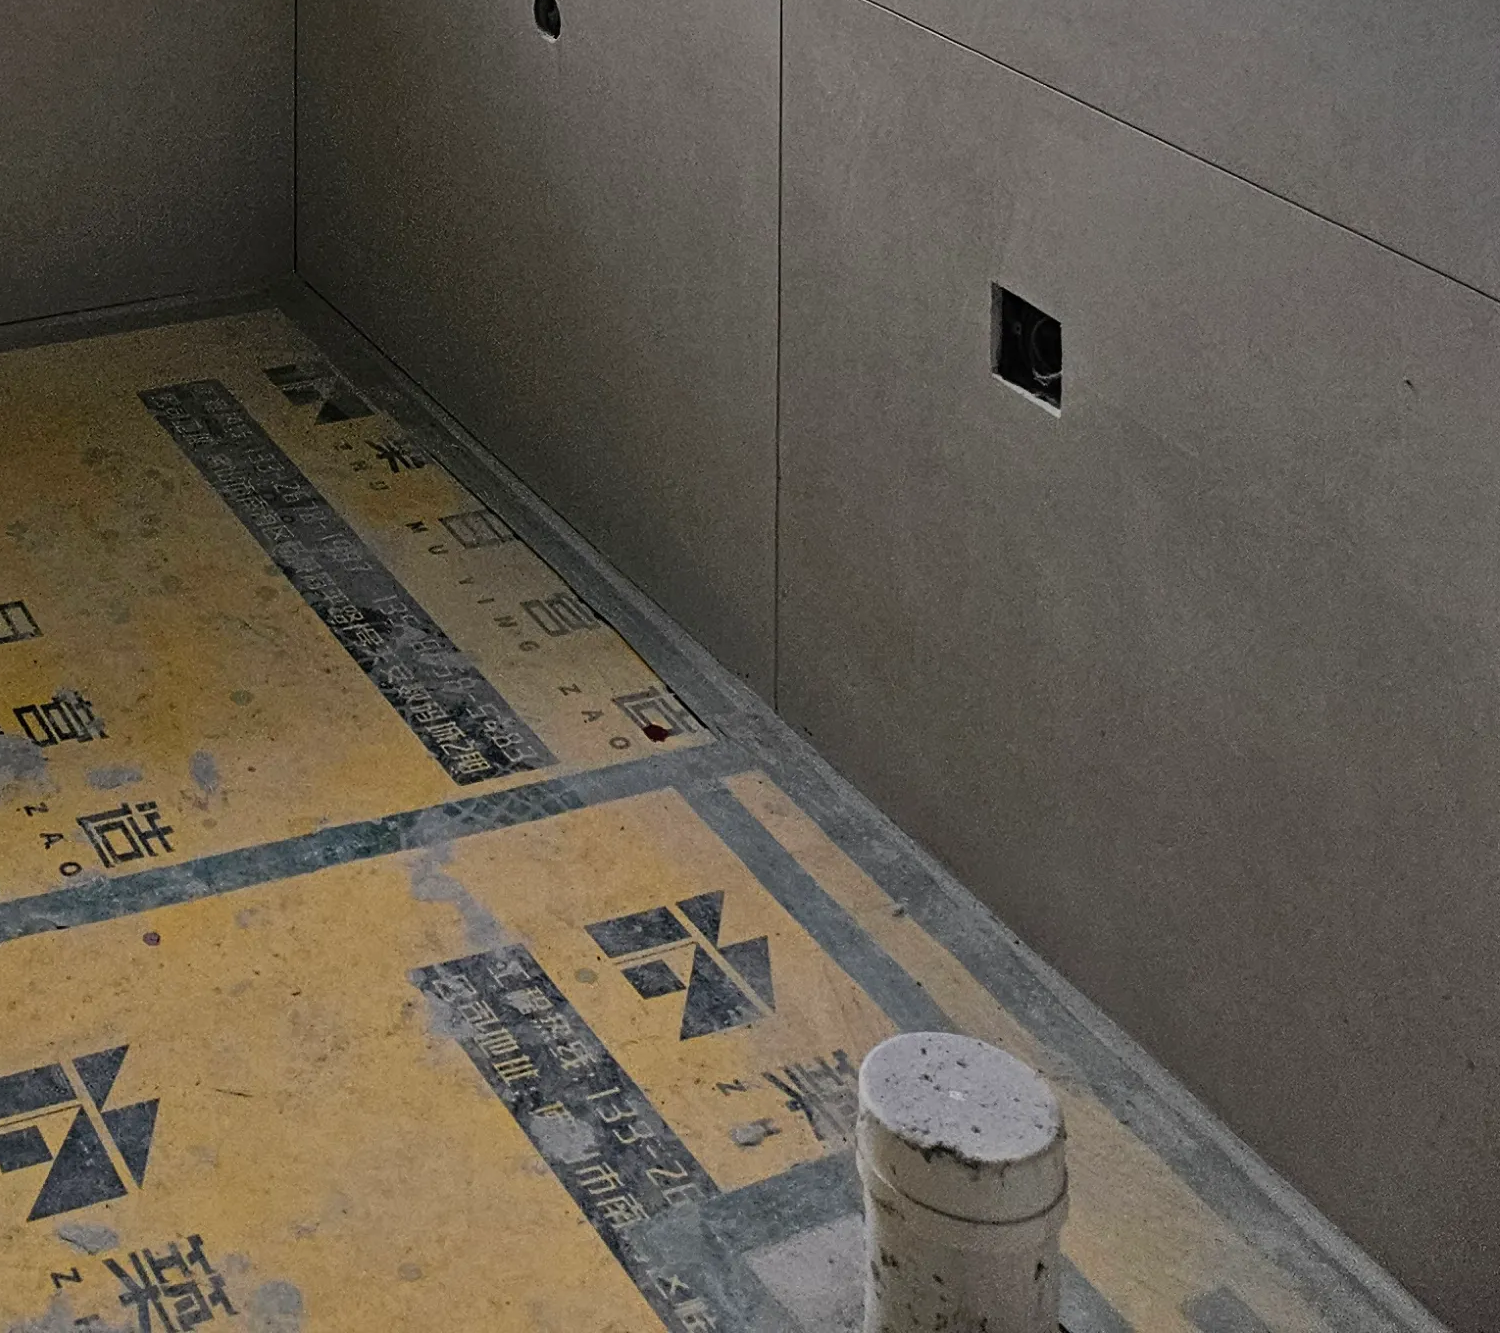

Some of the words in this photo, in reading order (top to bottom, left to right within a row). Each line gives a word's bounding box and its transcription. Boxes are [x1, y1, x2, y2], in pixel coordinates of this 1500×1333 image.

[406, 521, 449, 555] MU
[459, 575, 541, 653] YING
[559, 685, 631, 750] ZAO
[23, 802, 82, 877] ZAO
